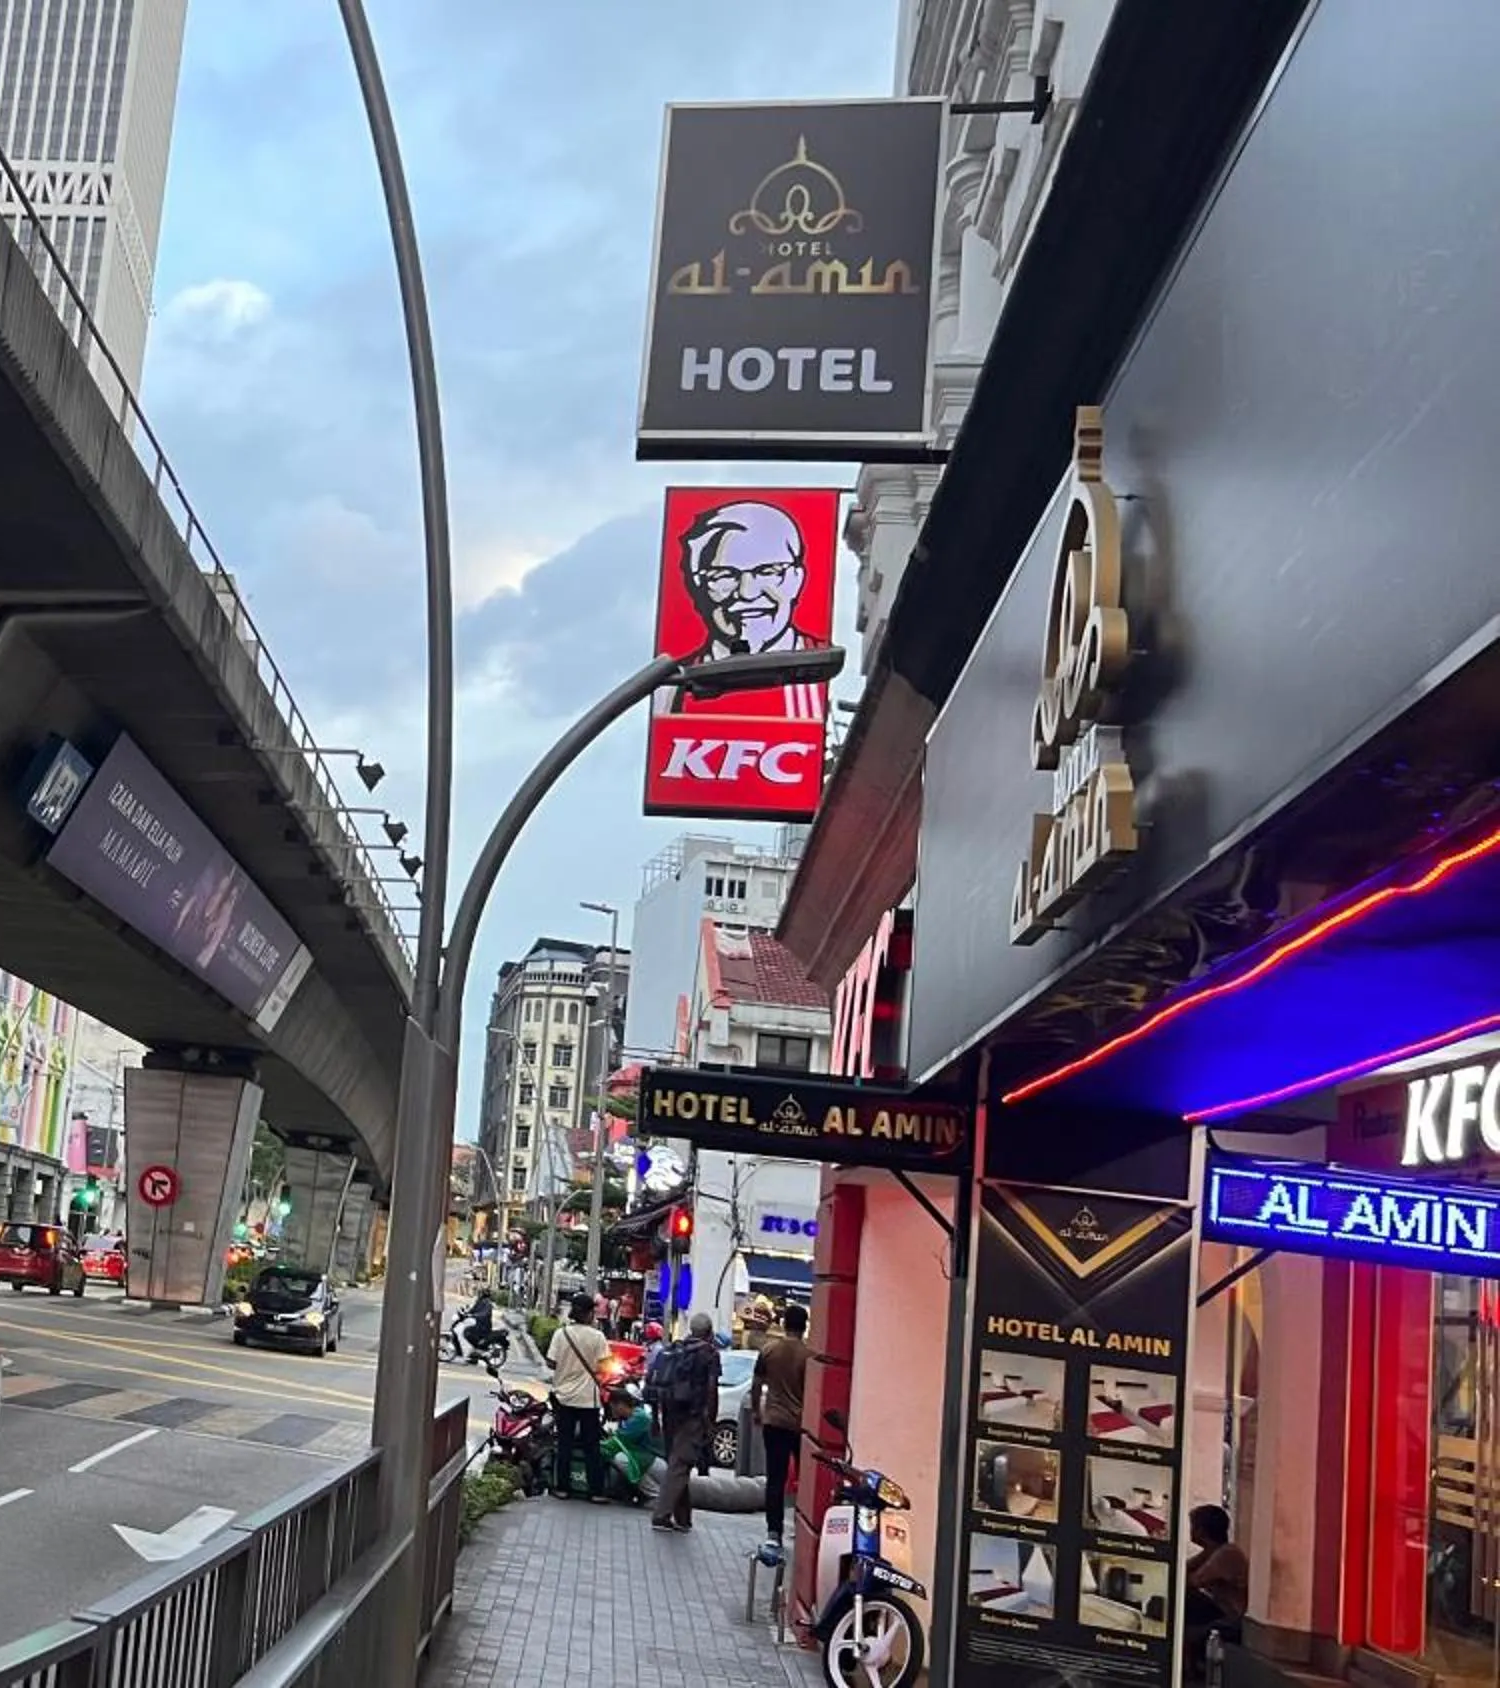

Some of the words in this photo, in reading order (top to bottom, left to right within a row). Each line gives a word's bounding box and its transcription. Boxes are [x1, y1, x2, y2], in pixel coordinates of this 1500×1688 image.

[680, 347, 894, 392] HOTEL
[660, 737, 817, 784] KFC
[653, 1088, 757, 1126] HOTEL
[822, 1106, 864, 1136] AL
[870, 1110, 958, 1145] AMIN
[1256, 1183, 1329, 1230] AL
[1340, 1193, 1487, 1250] AMIN
[987, 1315, 1066, 1344] HOTEL
[1069, 1327, 1100, 1348] AL
[1105, 1332, 1172, 1358] AMIN
